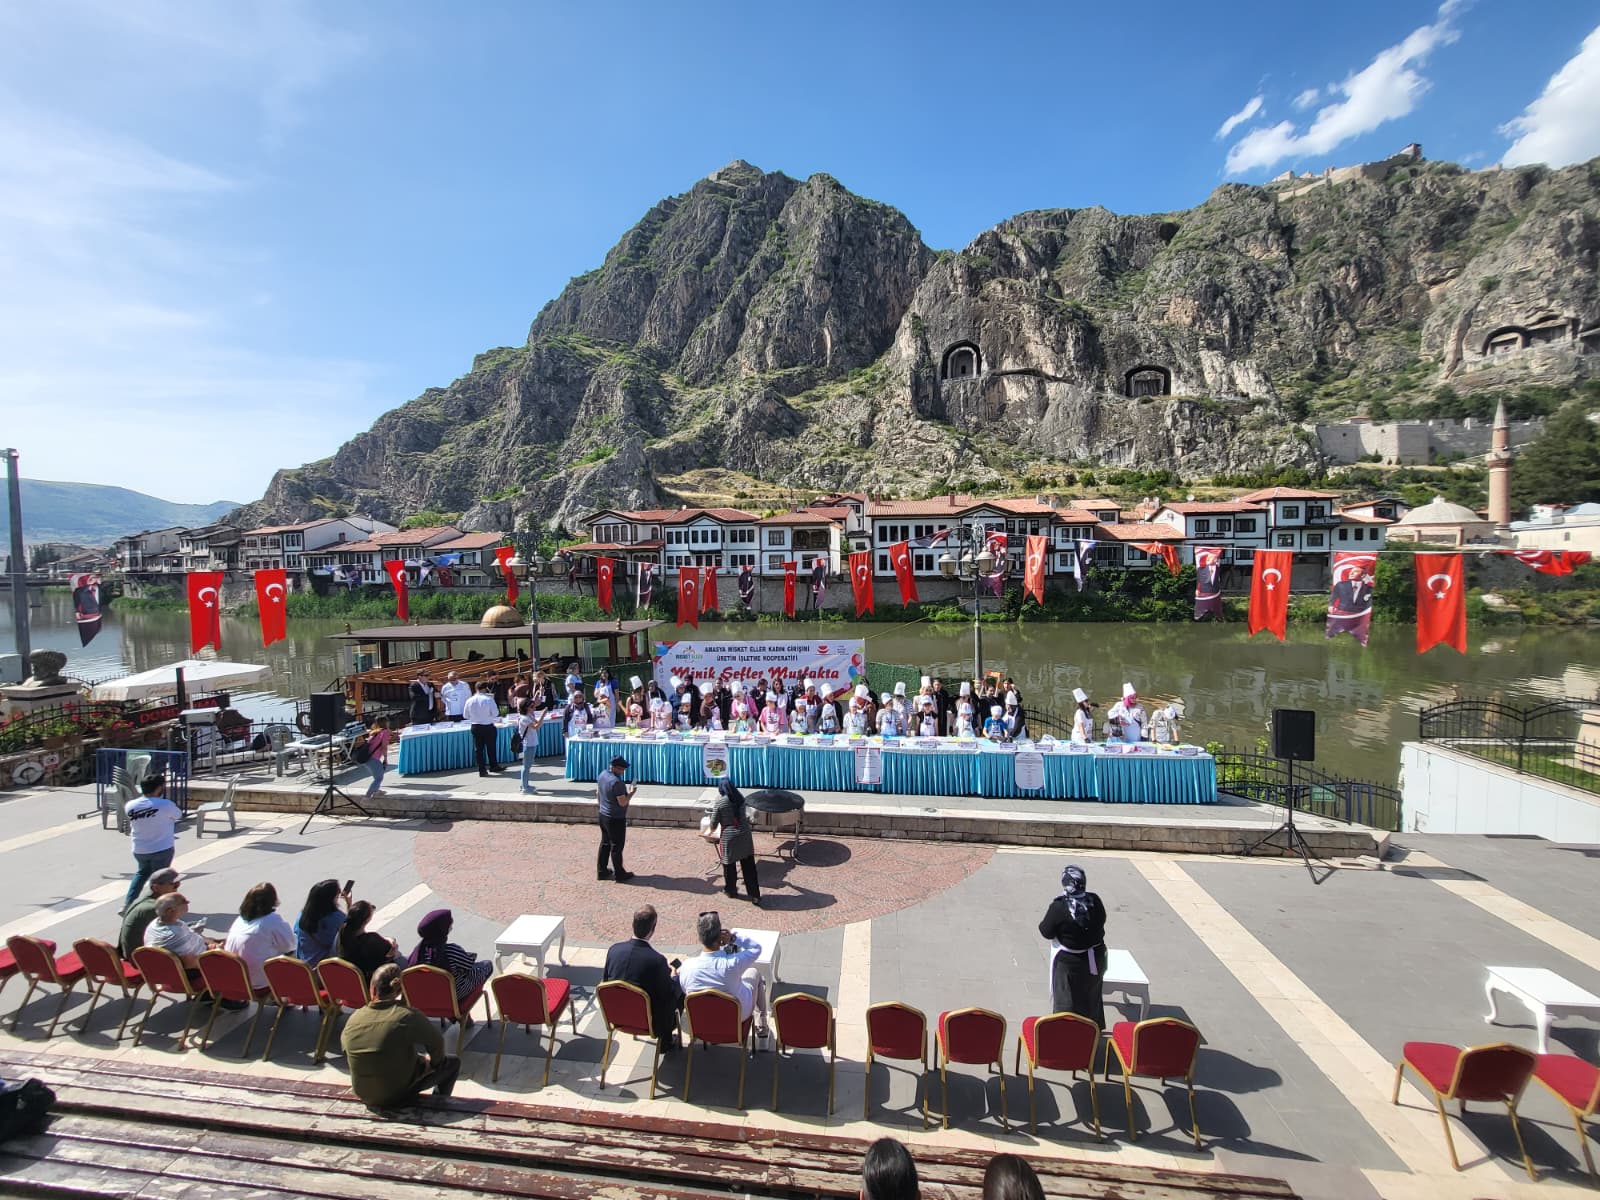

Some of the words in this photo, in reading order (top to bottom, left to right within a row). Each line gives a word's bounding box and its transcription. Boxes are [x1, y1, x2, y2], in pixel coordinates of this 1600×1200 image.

[670, 666, 716, 680] Minik
[720, 666, 764, 682] Şefler
[768, 665, 839, 680] Mutfakta
